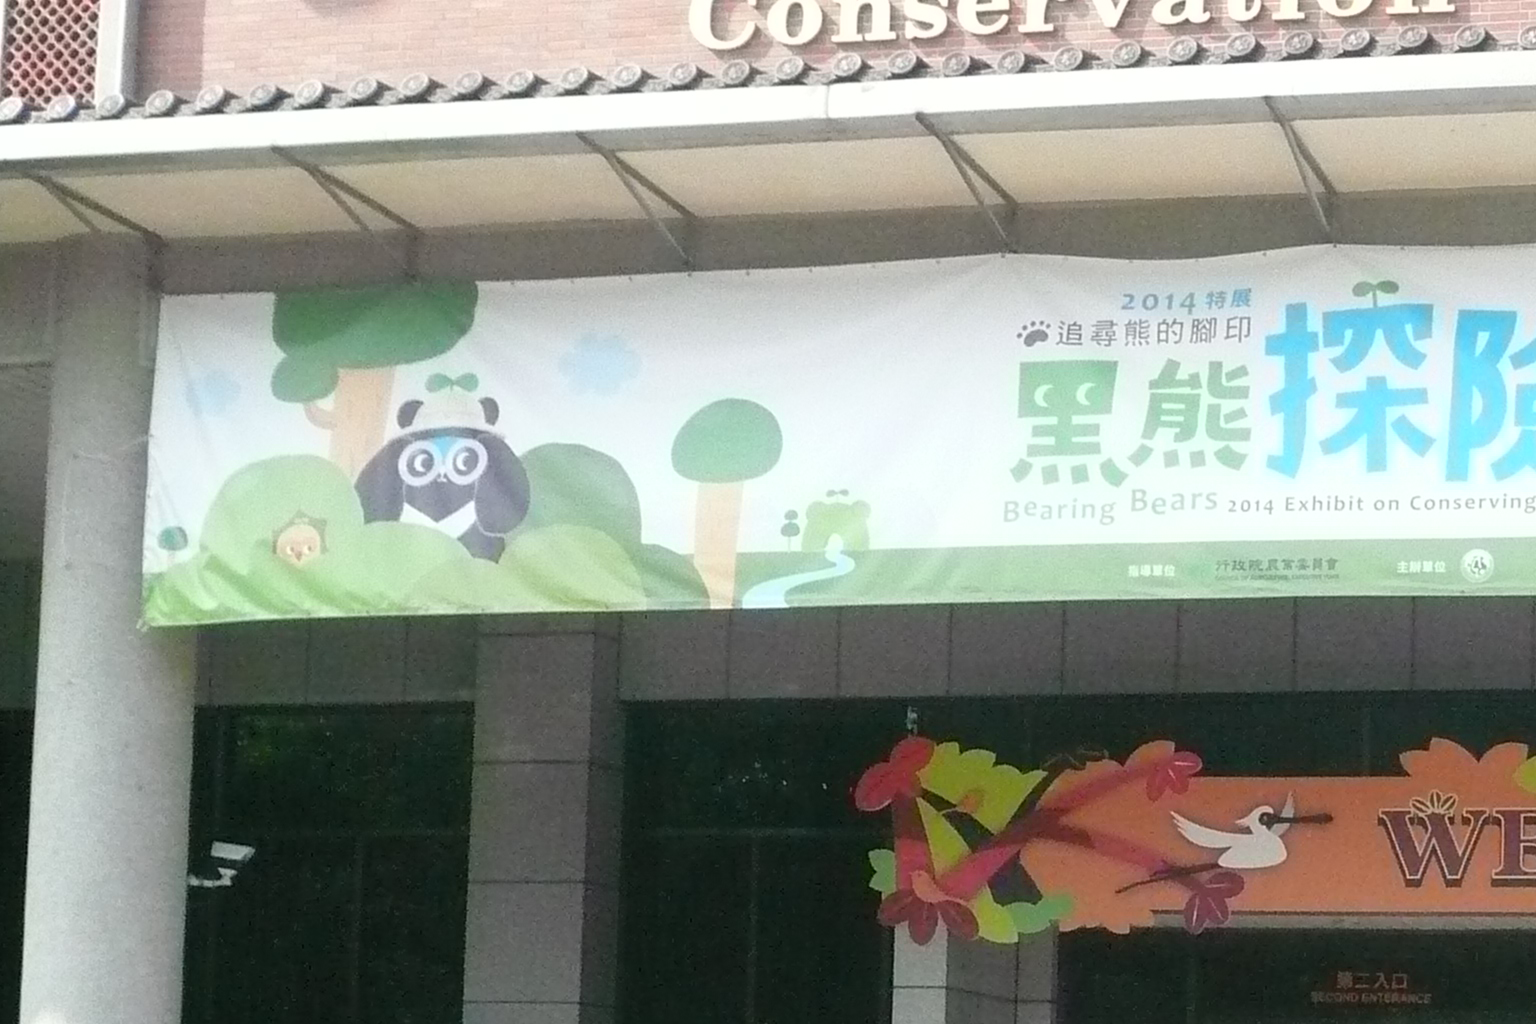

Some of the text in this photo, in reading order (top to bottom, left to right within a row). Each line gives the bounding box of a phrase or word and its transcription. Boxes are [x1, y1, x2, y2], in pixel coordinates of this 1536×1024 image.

[1055, 315, 1253, 348] 追尋熊的腳印
[1002, 488, 1219, 526] Bearing Bears
[1227, 496, 1276, 515] 2014
[1284, 495, 1365, 513] Exhibit
[1373, 499, 1400, 512] on
[1336, 971, 1408, 989] 第二入口
